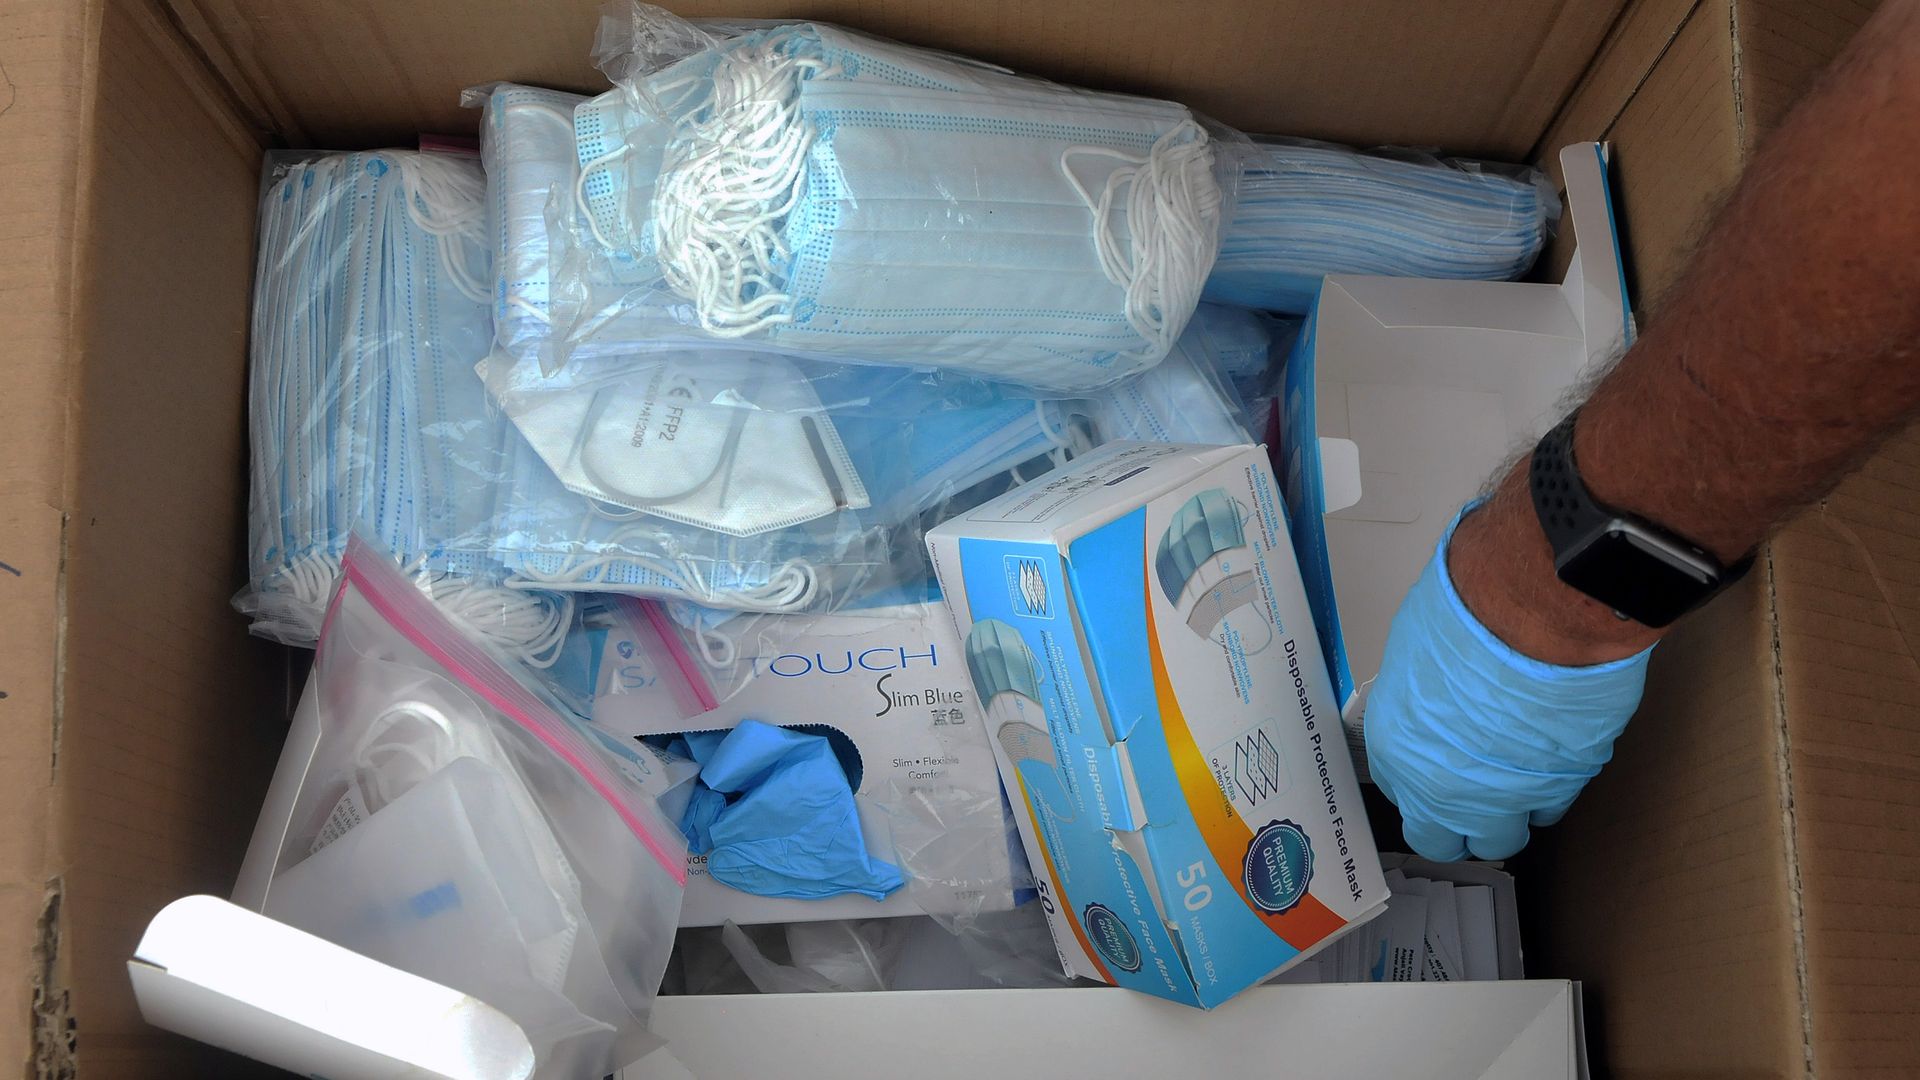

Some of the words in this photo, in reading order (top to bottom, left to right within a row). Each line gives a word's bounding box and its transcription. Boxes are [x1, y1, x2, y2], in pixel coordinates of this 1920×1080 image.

[659, 406, 684, 441] FFP2
[1244, 466, 1254, 490] Effective
[1251, 490, 1259, 508] barrier
[1255, 509, 1264, 529] against
[1261, 529, 1270, 551] droplets
[1253, 541, 1262, 558] MELT
[1259, 560, 1270, 586] BLOWN
[1272, 608, 1284, 634] CLOTH
[1264, 601, 1274, 624] particles
[739, 644, 938, 678] TOUCH
[1225, 655, 1237, 686] comfortable
[876, 673, 919, 717] Slim
[925, 688, 963, 705] Blue
[893, 758, 912, 768] Slim
[1282, 639, 1316, 731] Disposable
[1310, 732, 1337, 815] Protective
[1332, 817, 1348, 856] Face
[1344, 858, 1362, 902] Mask
[1212, 758, 1218, 769] OF
[1216, 770, 1233, 818] PROTECTION
[1224, 770, 1237, 802] LAYERS
[688, 868, 707, 876] Non-
[1084, 748, 1113, 836] Disposabl
[1108, 840, 1141, 916] rotective
[1138, 920, 1157, 954] Face
[1155, 957, 1177, 993] Mask
[1263, 847, 1284, 896] QUALITY
[1272, 836, 1294, 894] PREMIUM
[1034, 876, 1055, 914] 50
[1177, 860, 1212, 911] 50
[1098, 918, 1120, 958] QUALITY
[1104, 917, 1129, 964] PREMIUM
[1190, 916, 1208, 954] MASKS
[1205, 960, 1218, 985] BOX
